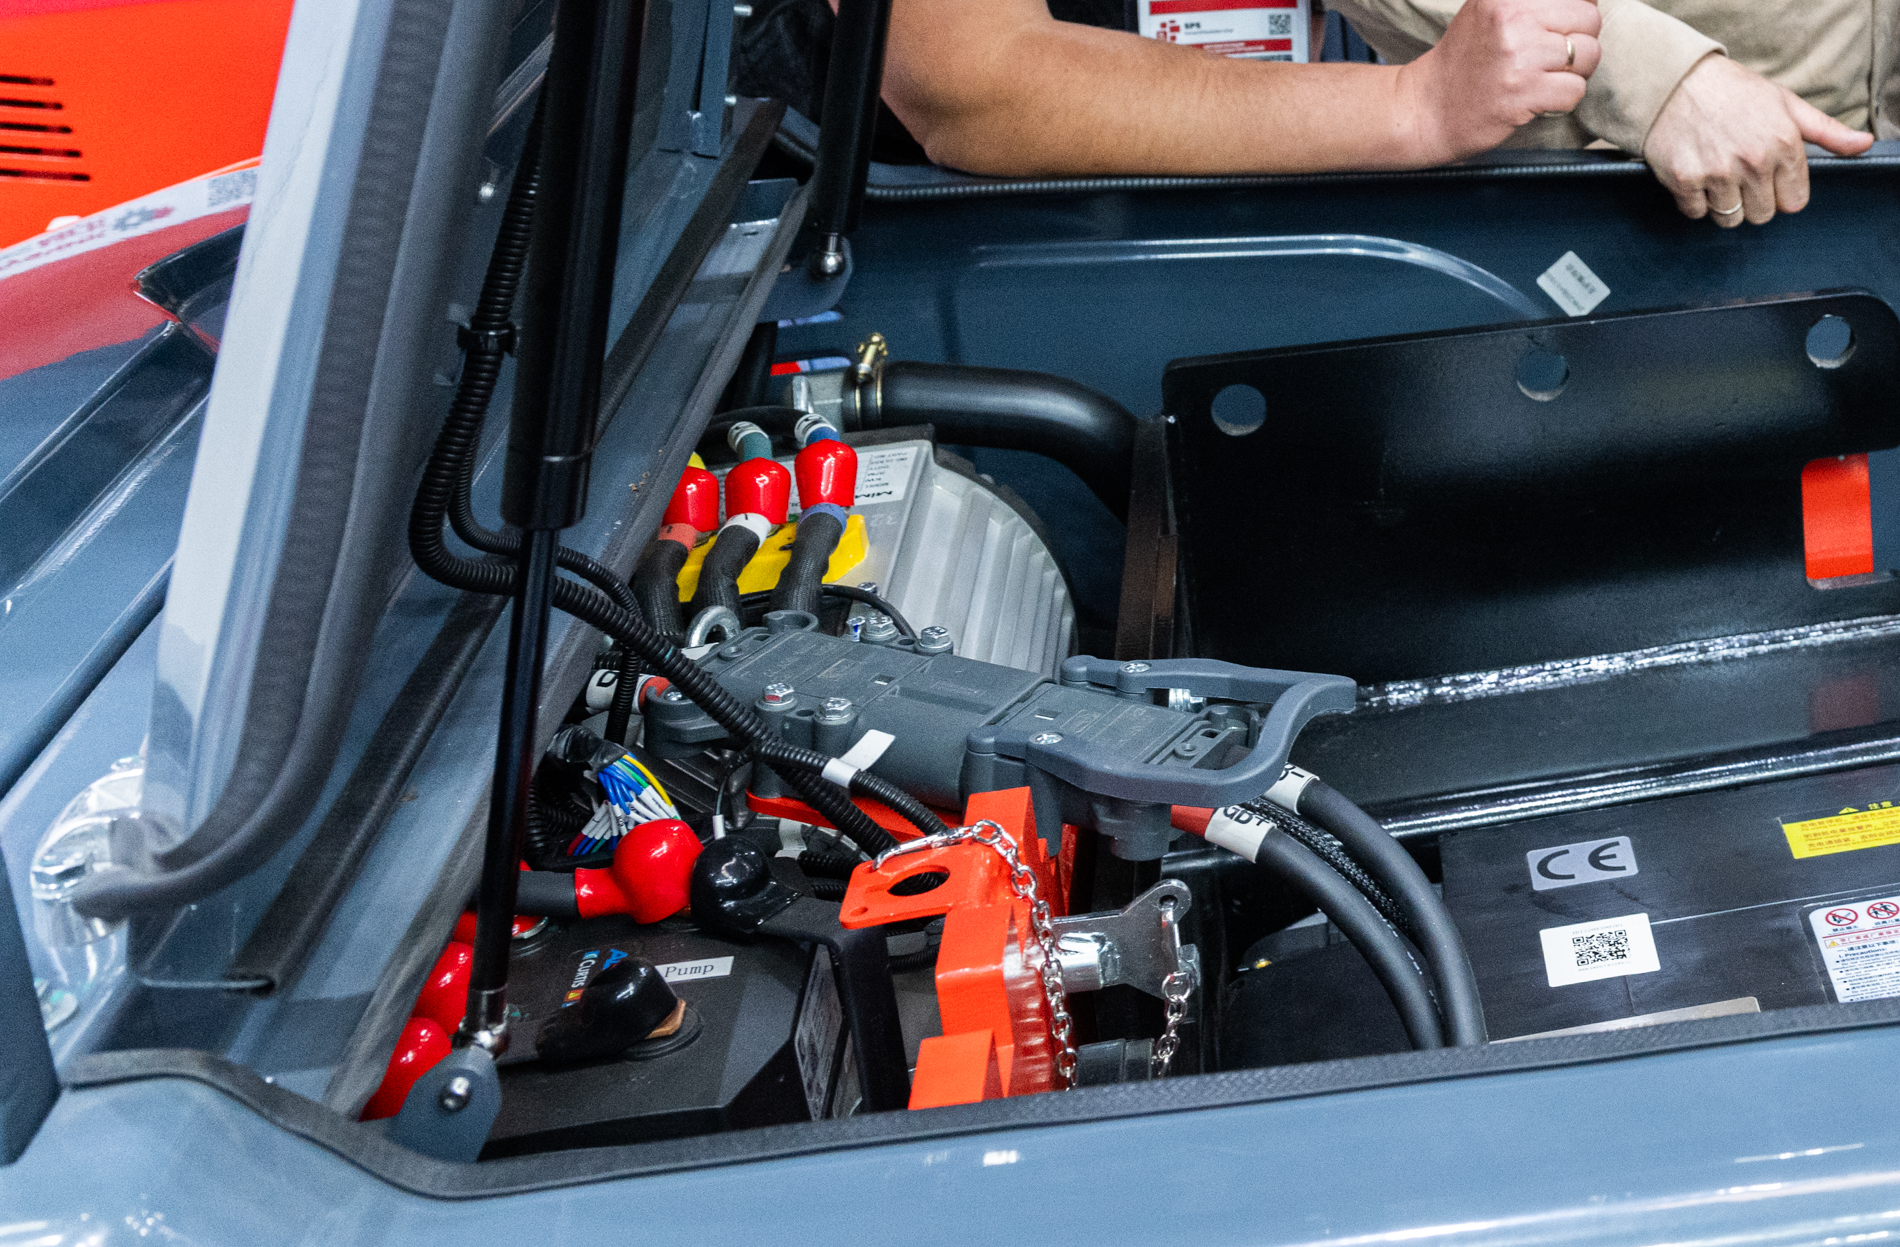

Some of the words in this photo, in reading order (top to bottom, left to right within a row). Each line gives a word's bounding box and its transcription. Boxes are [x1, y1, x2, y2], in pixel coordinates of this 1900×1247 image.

[1536, 840, 1627, 881] CE
[571, 958, 596, 989] CURTIS
[664, 963, 715, 978] Pump
